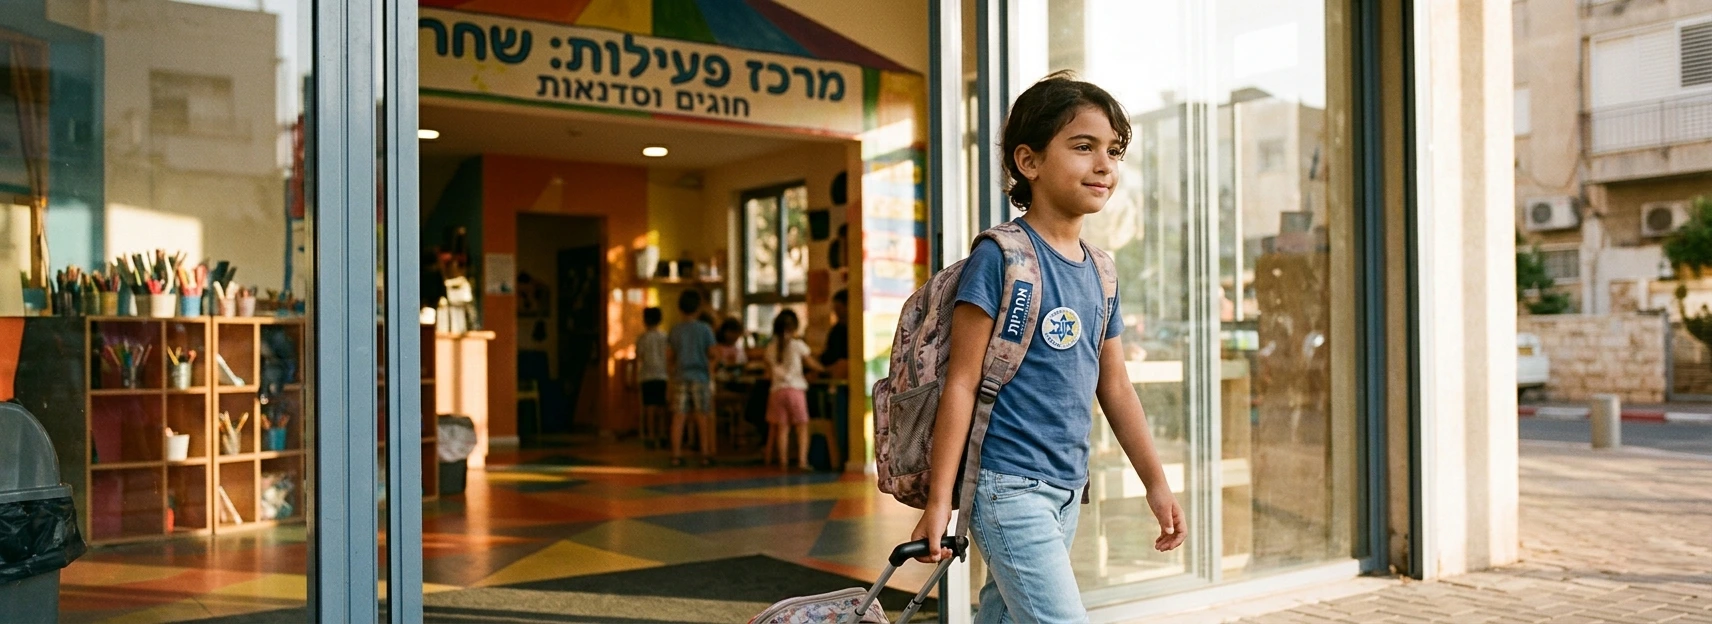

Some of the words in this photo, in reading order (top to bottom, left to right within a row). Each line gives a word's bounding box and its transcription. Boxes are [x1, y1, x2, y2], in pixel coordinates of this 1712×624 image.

[418, 17, 533, 64] שחר
[550, 34, 732, 88] פעילות:
[537, 75, 663, 108] וסדנאות
[676, 89, 750, 117] חוגים
[745, 59, 846, 102] מרכז
[1008, 287, 1028, 336] אחריות
